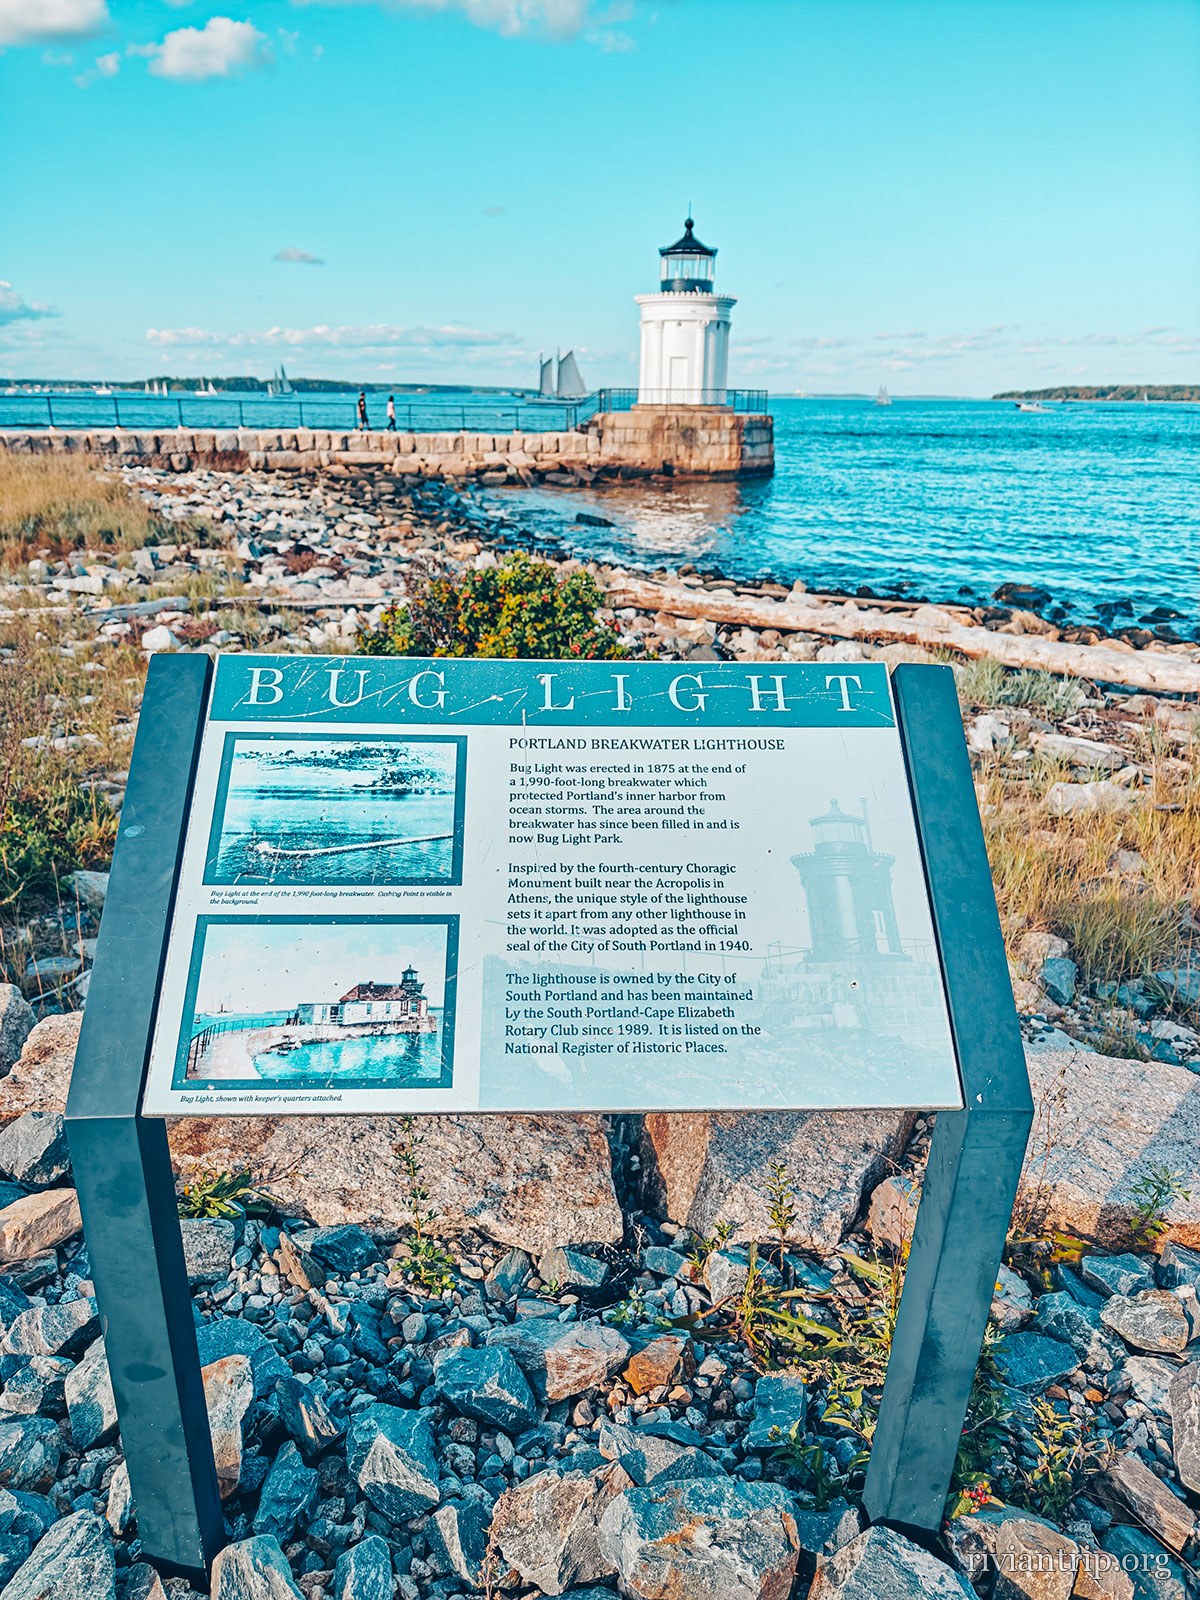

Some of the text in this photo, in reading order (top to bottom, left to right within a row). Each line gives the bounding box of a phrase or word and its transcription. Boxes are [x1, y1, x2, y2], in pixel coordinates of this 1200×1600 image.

[242, 667, 862, 712] BUG LIGHT
[509, 738, 785, 750] PORTLAND BREAKWATER LIGHTHOUSE
[510, 763, 532, 774] Bug
[535, 763, 563, 774] Light
[589, 764, 631, 773] erected
[633, 764, 644, 773] in
[648, 764, 675, 773] 1875
[678, 765, 689, 773] at
[691, 764, 709, 773] the
[711, 764, 732, 773] end
[735, 764, 747, 773] of
[520, 777, 605, 789] 1,990-foot-long
[608, 777, 672, 787] breakwater
[674, 777, 707, 787] which
[509, 791, 726, 802] protected Portland's inner harbor from
[545, 806, 587, 815] storms.
[592, 805, 614, 815] The
[617, 807, 641, 815] area
[644, 805, 684, 815] around
[687, 805, 705, 815] the
[509, 819, 740, 829] breakwater has since been filled in and is
[537, 833, 559, 845] Bug
[562, 833, 591, 845] Light
[594, 833, 623, 843] Park.
[508, 862, 736, 875] Inspired by the fourth-century Choragic
[508, 877, 724, 891] Monument built near the Acropolis in
[211, 890, 224, 898] Bug
[225, 890, 240, 898] Light
[273, 890, 281, 898] of
[292, 890, 309, 898] 1,990
[309, 890, 338, 899] foot-long
[339, 890, 375, 898] breakwater.
[507, 893, 748, 906] Athens, the unique style of the lighthouse
[221, 898, 259, 906] background.
[507, 908, 746, 921] sets it apart from any other lighthouse in
[507, 924, 738, 937] the world. It was adopted as the official
[506, 940, 753, 953] seal of the City of South Portland in 1940.
[505, 972, 737, 986] The lighthouse is owned by the City of
[505, 989, 753, 1001] South Portland and has been maintained
[505, 1006, 735, 1020] by the South Portland-Cape Elizabeth
[505, 1023, 761, 1038] Rotary Club since 1989. It is listed on the
[505, 1041, 727, 1056] National Register of Historic Places.
[180, 1095, 194, 1103] Bug
[195, 1095, 215, 1103] Light,
[255, 1094, 282, 1103] keeper's
[283, 1094, 312, 1103] quarters
[312, 1094, 343, 1102] attached.
